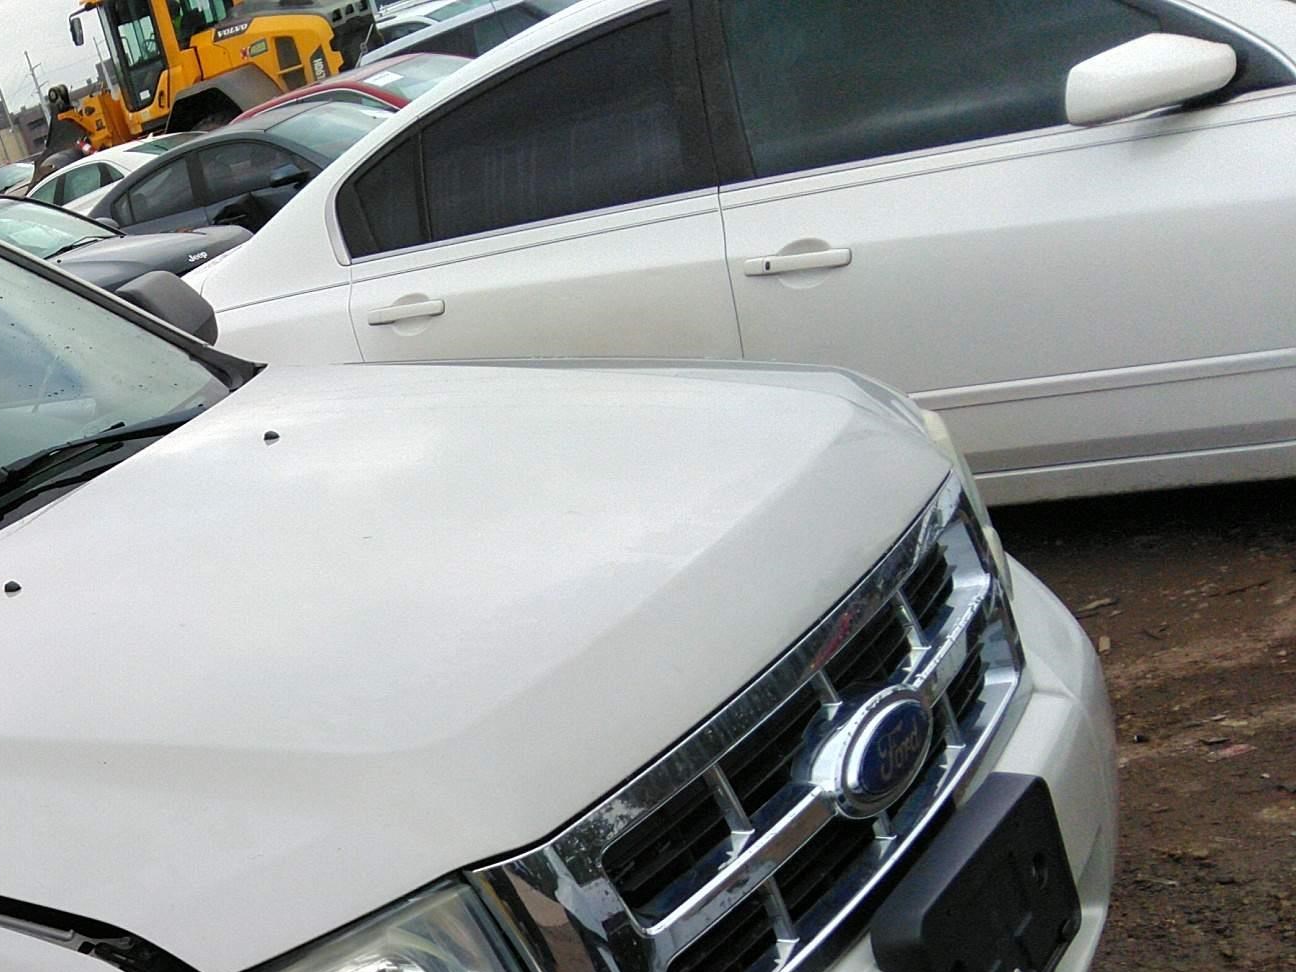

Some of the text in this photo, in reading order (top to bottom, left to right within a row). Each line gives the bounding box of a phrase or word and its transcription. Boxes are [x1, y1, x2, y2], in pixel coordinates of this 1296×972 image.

[217, 23, 248, 39] VOLVO
[188, 251, 208, 262] Jeep
[879, 715, 921, 781] Ford
